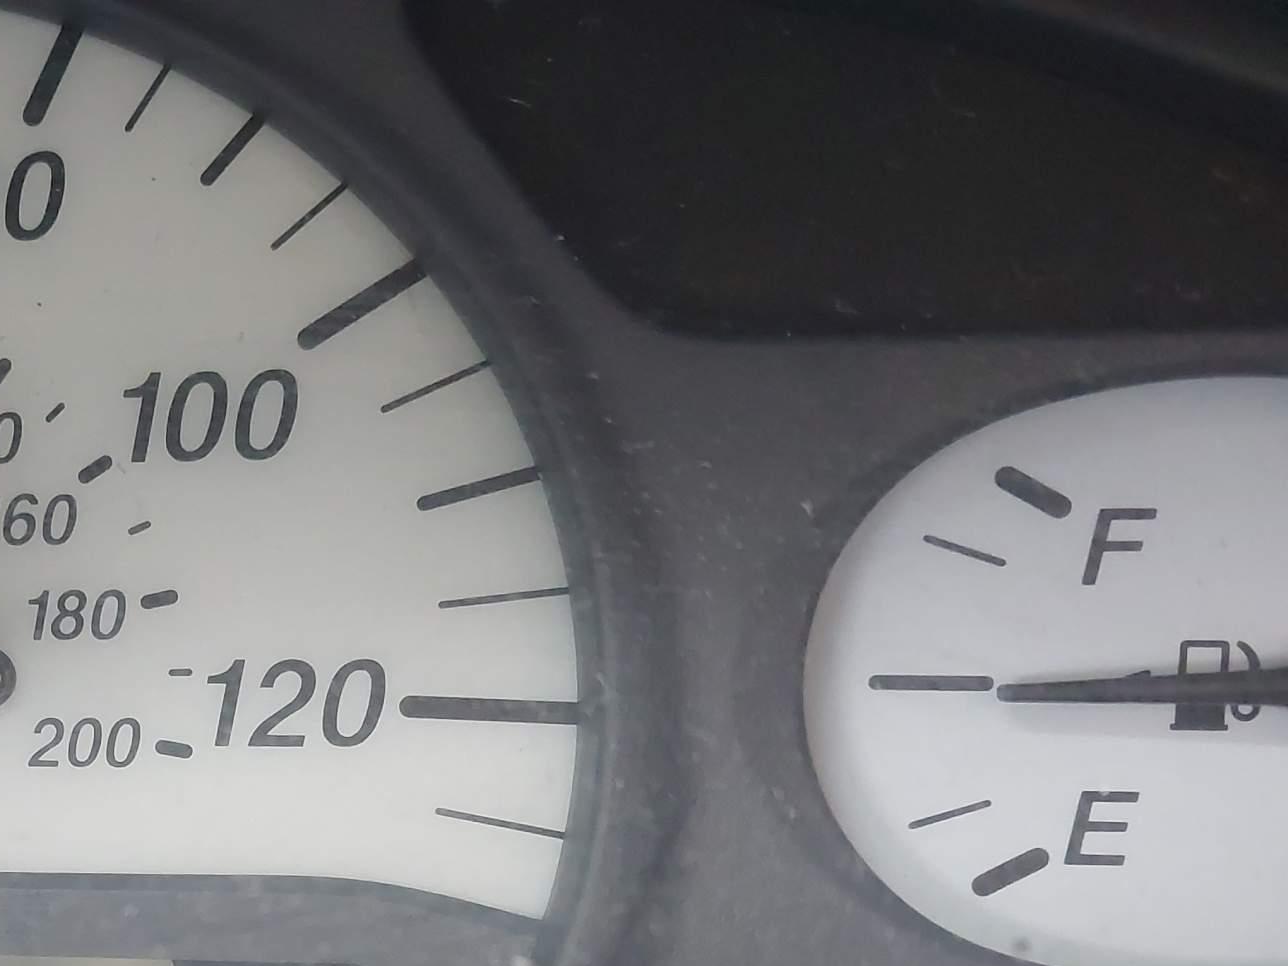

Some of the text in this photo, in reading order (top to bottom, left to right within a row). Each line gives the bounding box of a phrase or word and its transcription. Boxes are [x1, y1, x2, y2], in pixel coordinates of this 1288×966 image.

[123, 369, 298, 462] 100
[1082, 508, 1157, 585] F
[28, 590, 126, 640] 180
[207, 659, 385, 747] 120
[28, 718, 140, 767] 200
[1064, 791, 1139, 866] E
